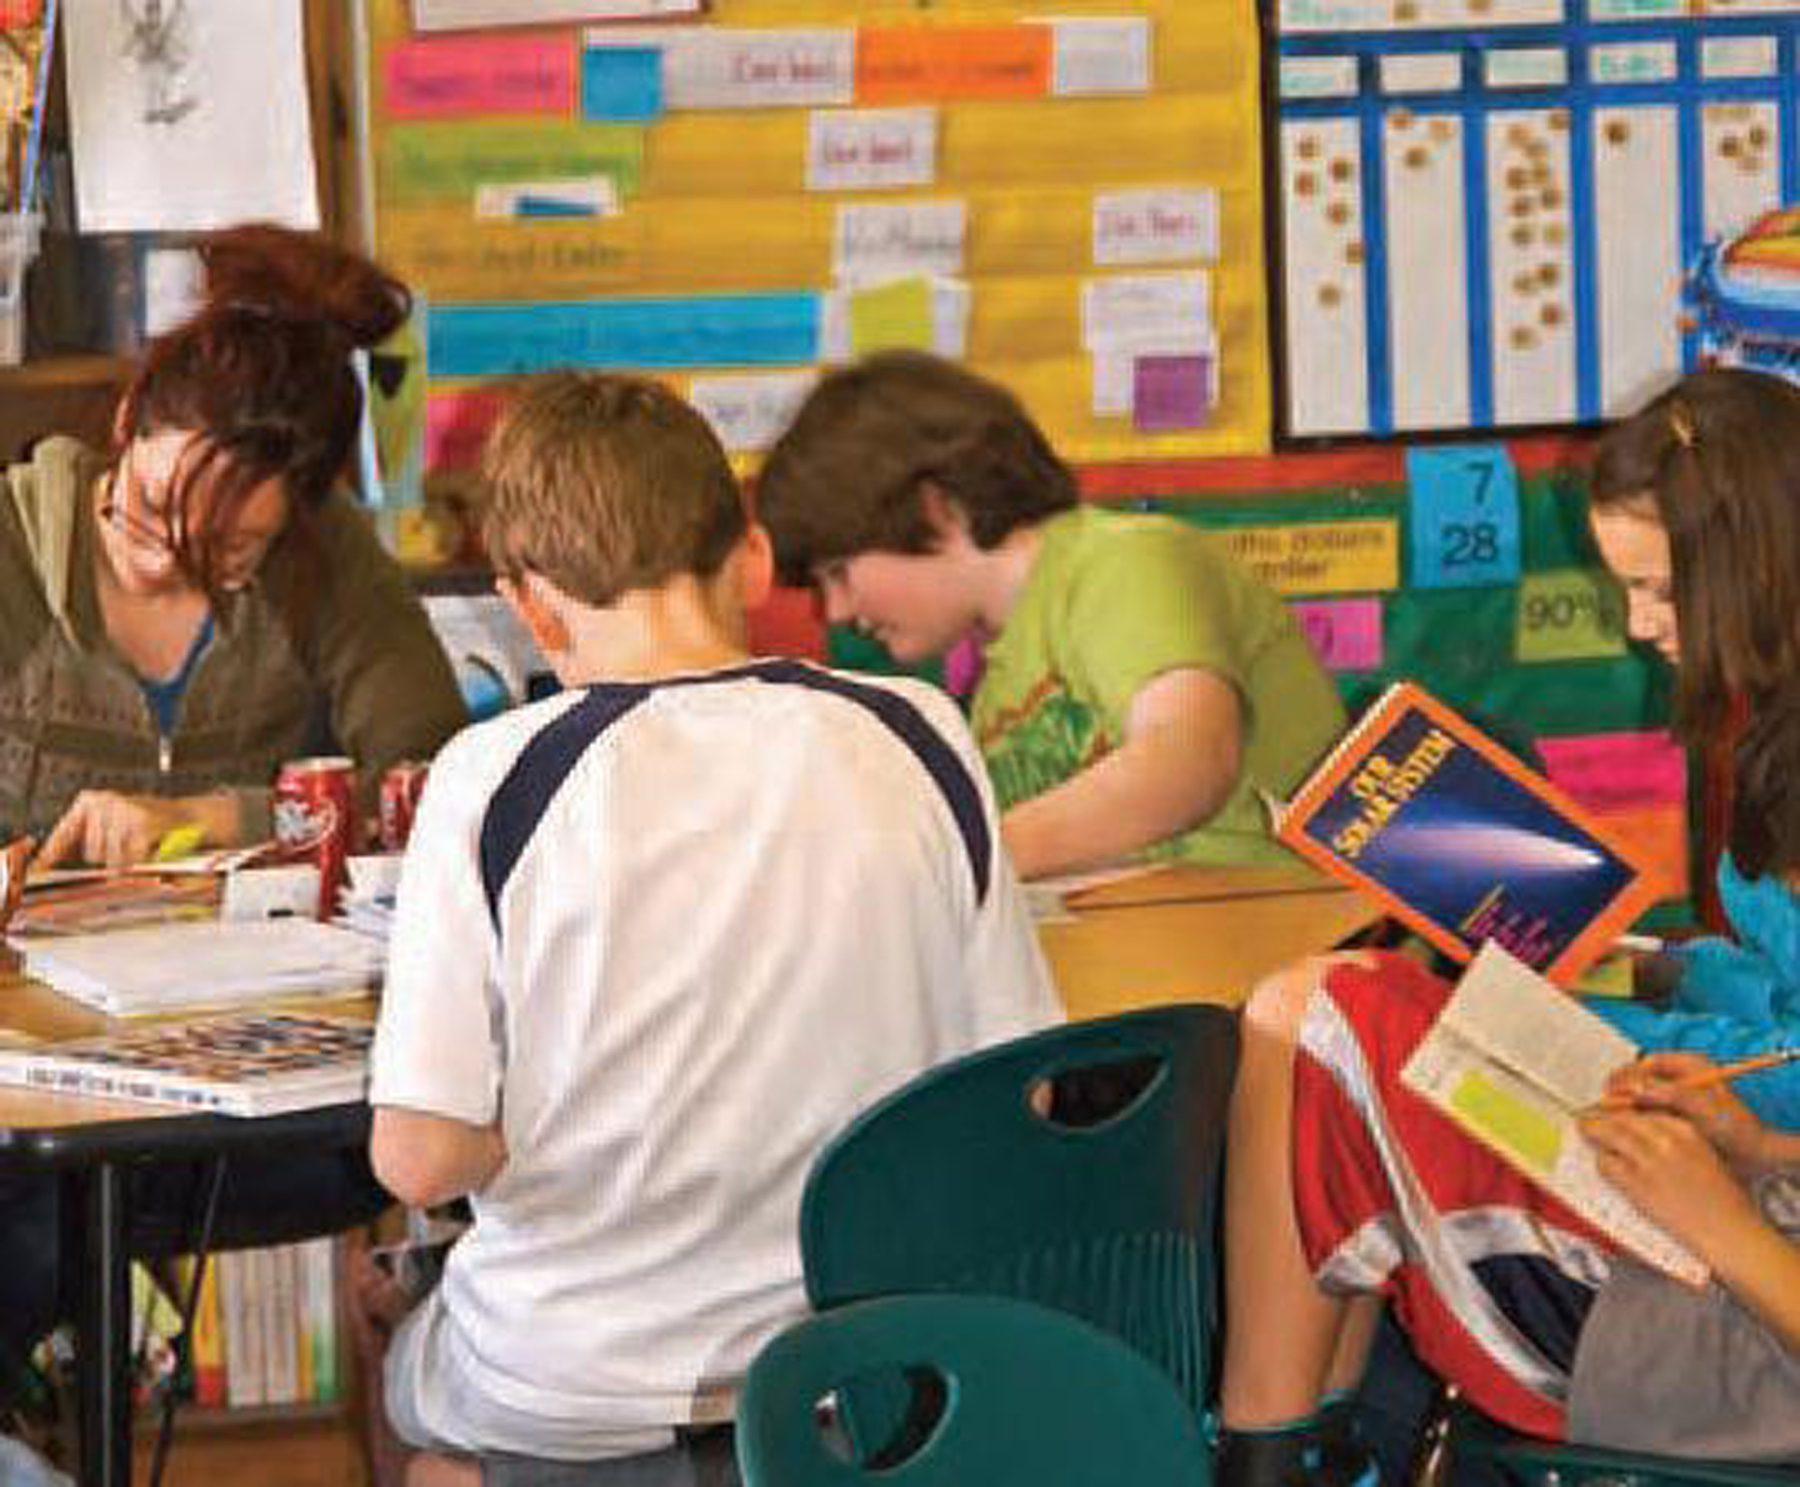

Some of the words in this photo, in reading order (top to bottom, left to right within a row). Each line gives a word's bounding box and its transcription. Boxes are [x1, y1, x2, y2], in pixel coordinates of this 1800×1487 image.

[1466, 460, 1494, 506] 7
[1440, 522, 1498, 564] 28
[1384, 728, 1455, 802] SYSTEM
